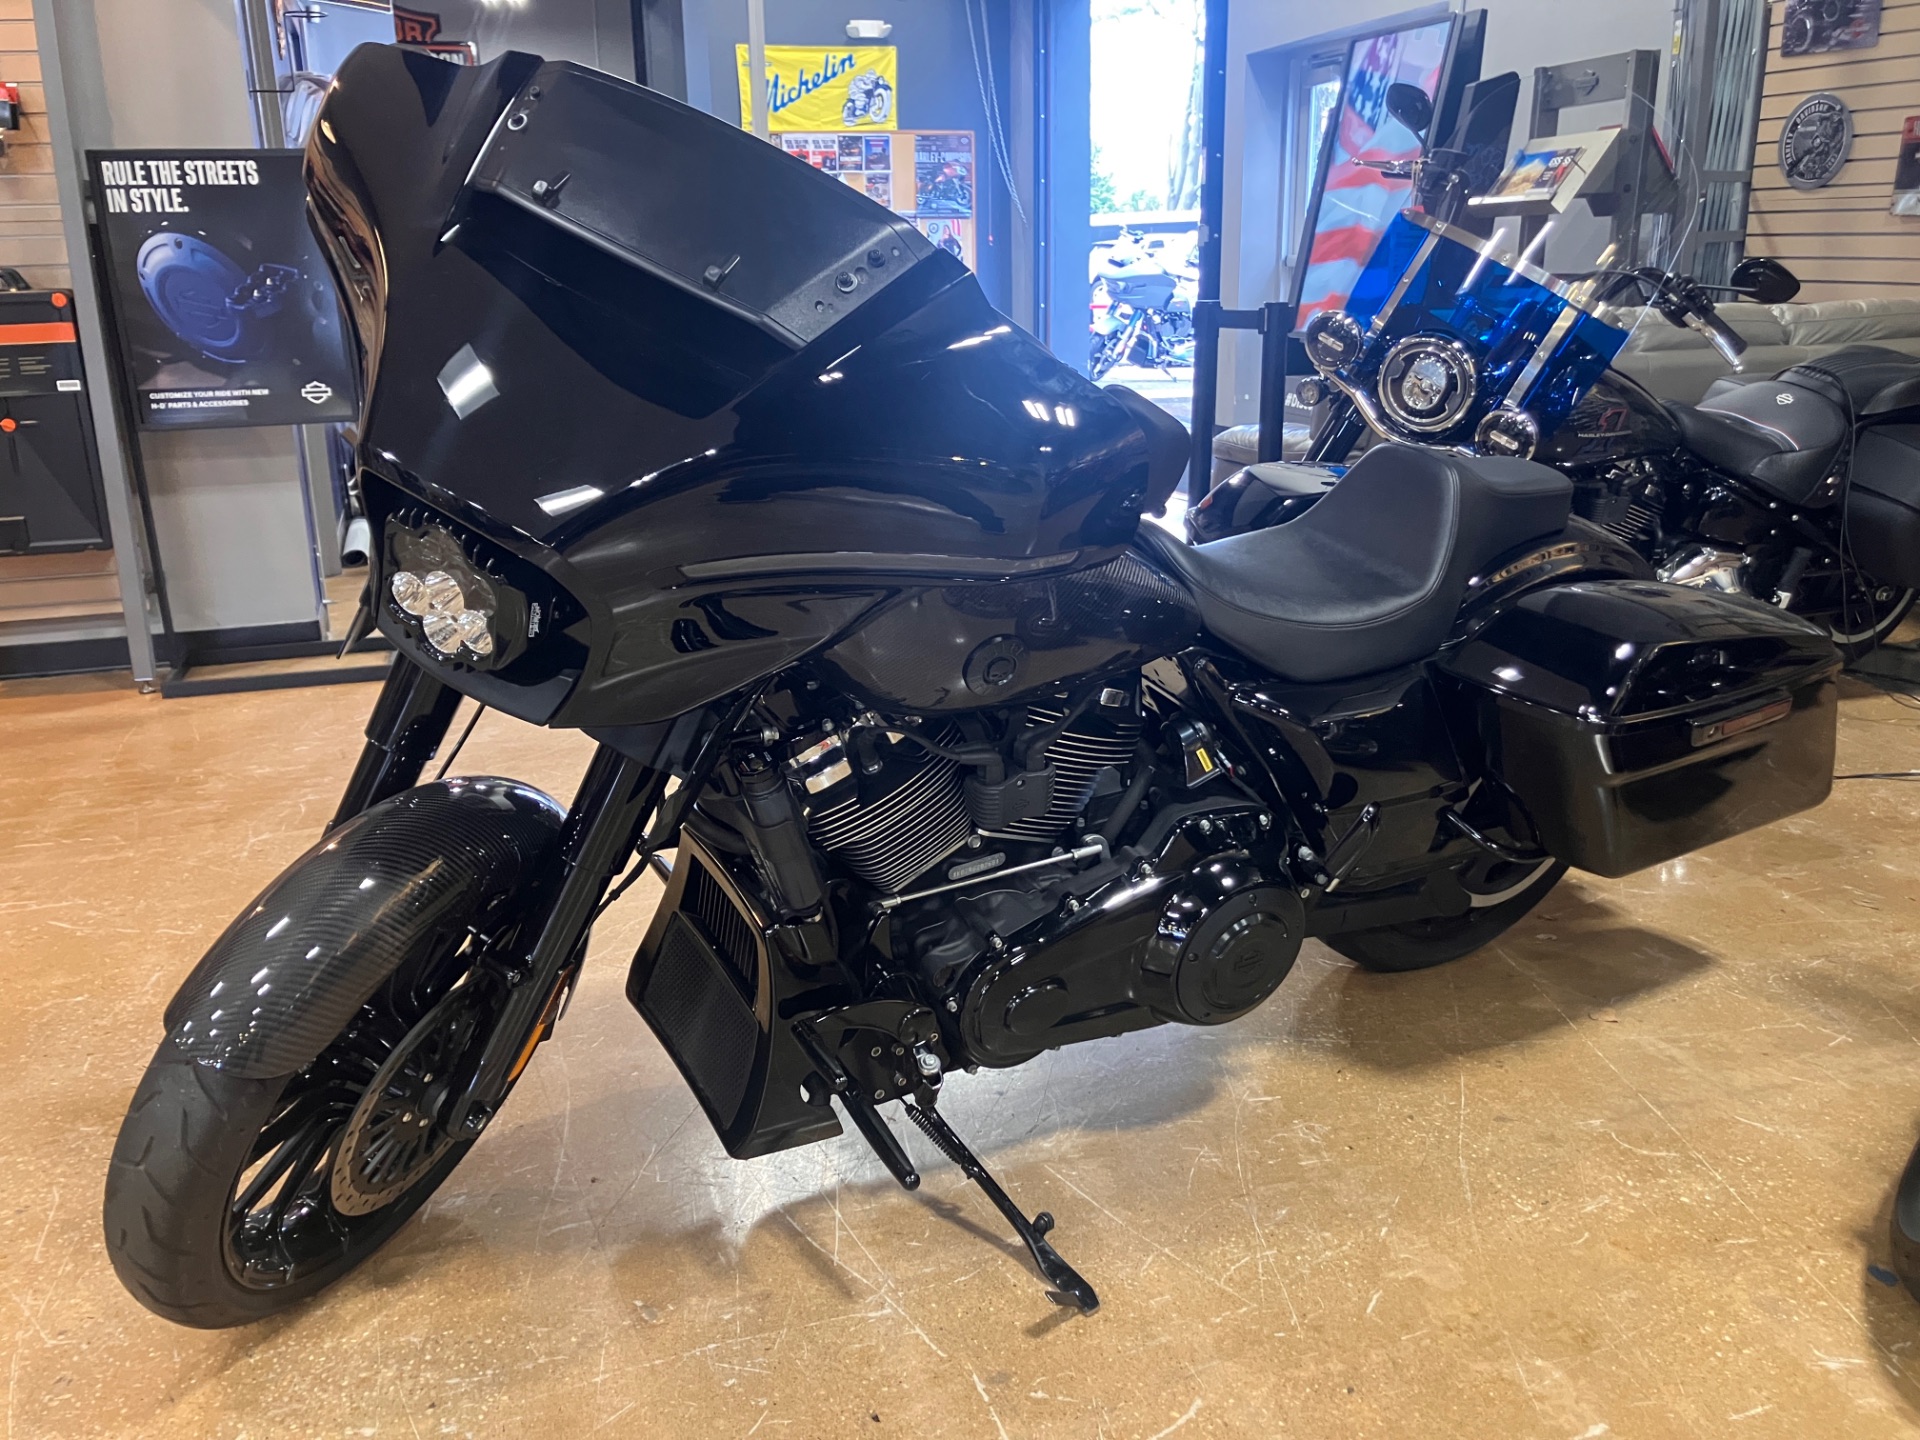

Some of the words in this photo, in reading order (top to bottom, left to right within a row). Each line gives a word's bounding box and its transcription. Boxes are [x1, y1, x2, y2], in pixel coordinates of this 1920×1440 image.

[101, 160, 148, 186] RULE
[147, 160, 183, 186] THE
[184, 160, 259, 186] STREETS
[106, 188, 128, 213] IN
[129, 188, 189, 213] STYLE.
[149, 391, 193, 399] CUSTOMIZE
[194, 390, 213, 398] YOUR
[214, 389, 231, 398] RIDE
[232, 388, 251, 397] WITH
[252, 388, 269, 396] NEW
[168, 400, 191, 409] PARTS
[193, 400, 198, 408] &
[199, 399, 249, 408] ACCESSORIES
